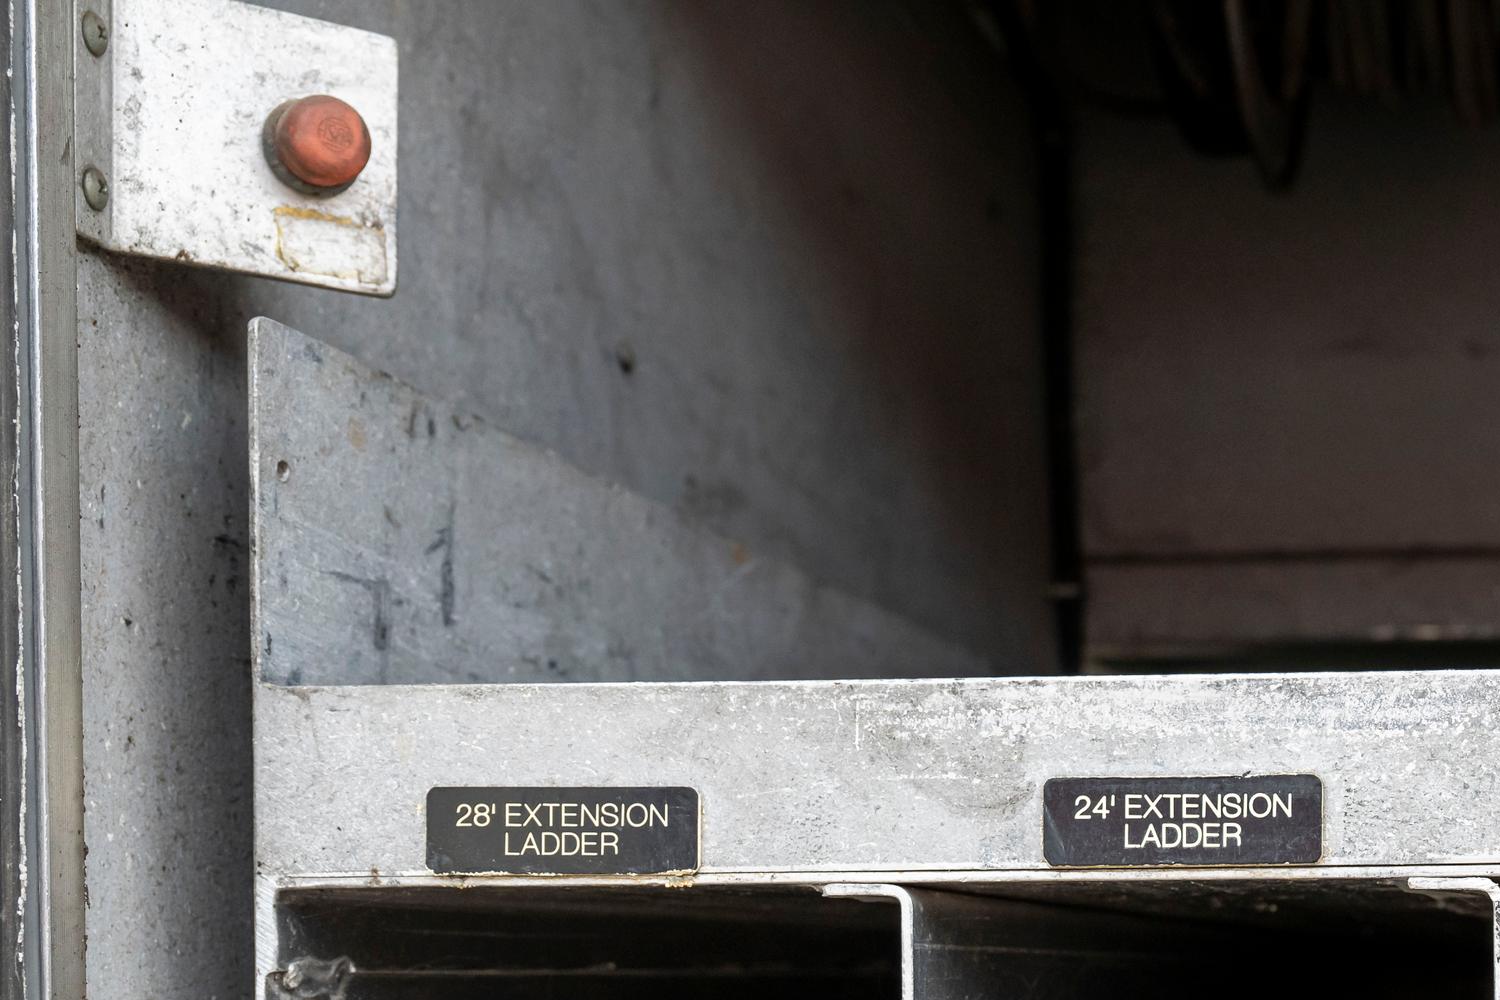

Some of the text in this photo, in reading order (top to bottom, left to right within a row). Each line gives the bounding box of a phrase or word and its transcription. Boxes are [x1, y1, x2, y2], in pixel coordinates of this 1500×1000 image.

[455, 803, 669, 828] 28' EXTENSION
[1074, 793, 1292, 820] 24' EXTENSION
[504, 832, 619, 856] LADDER
[1124, 823, 1242, 848] LADDER
